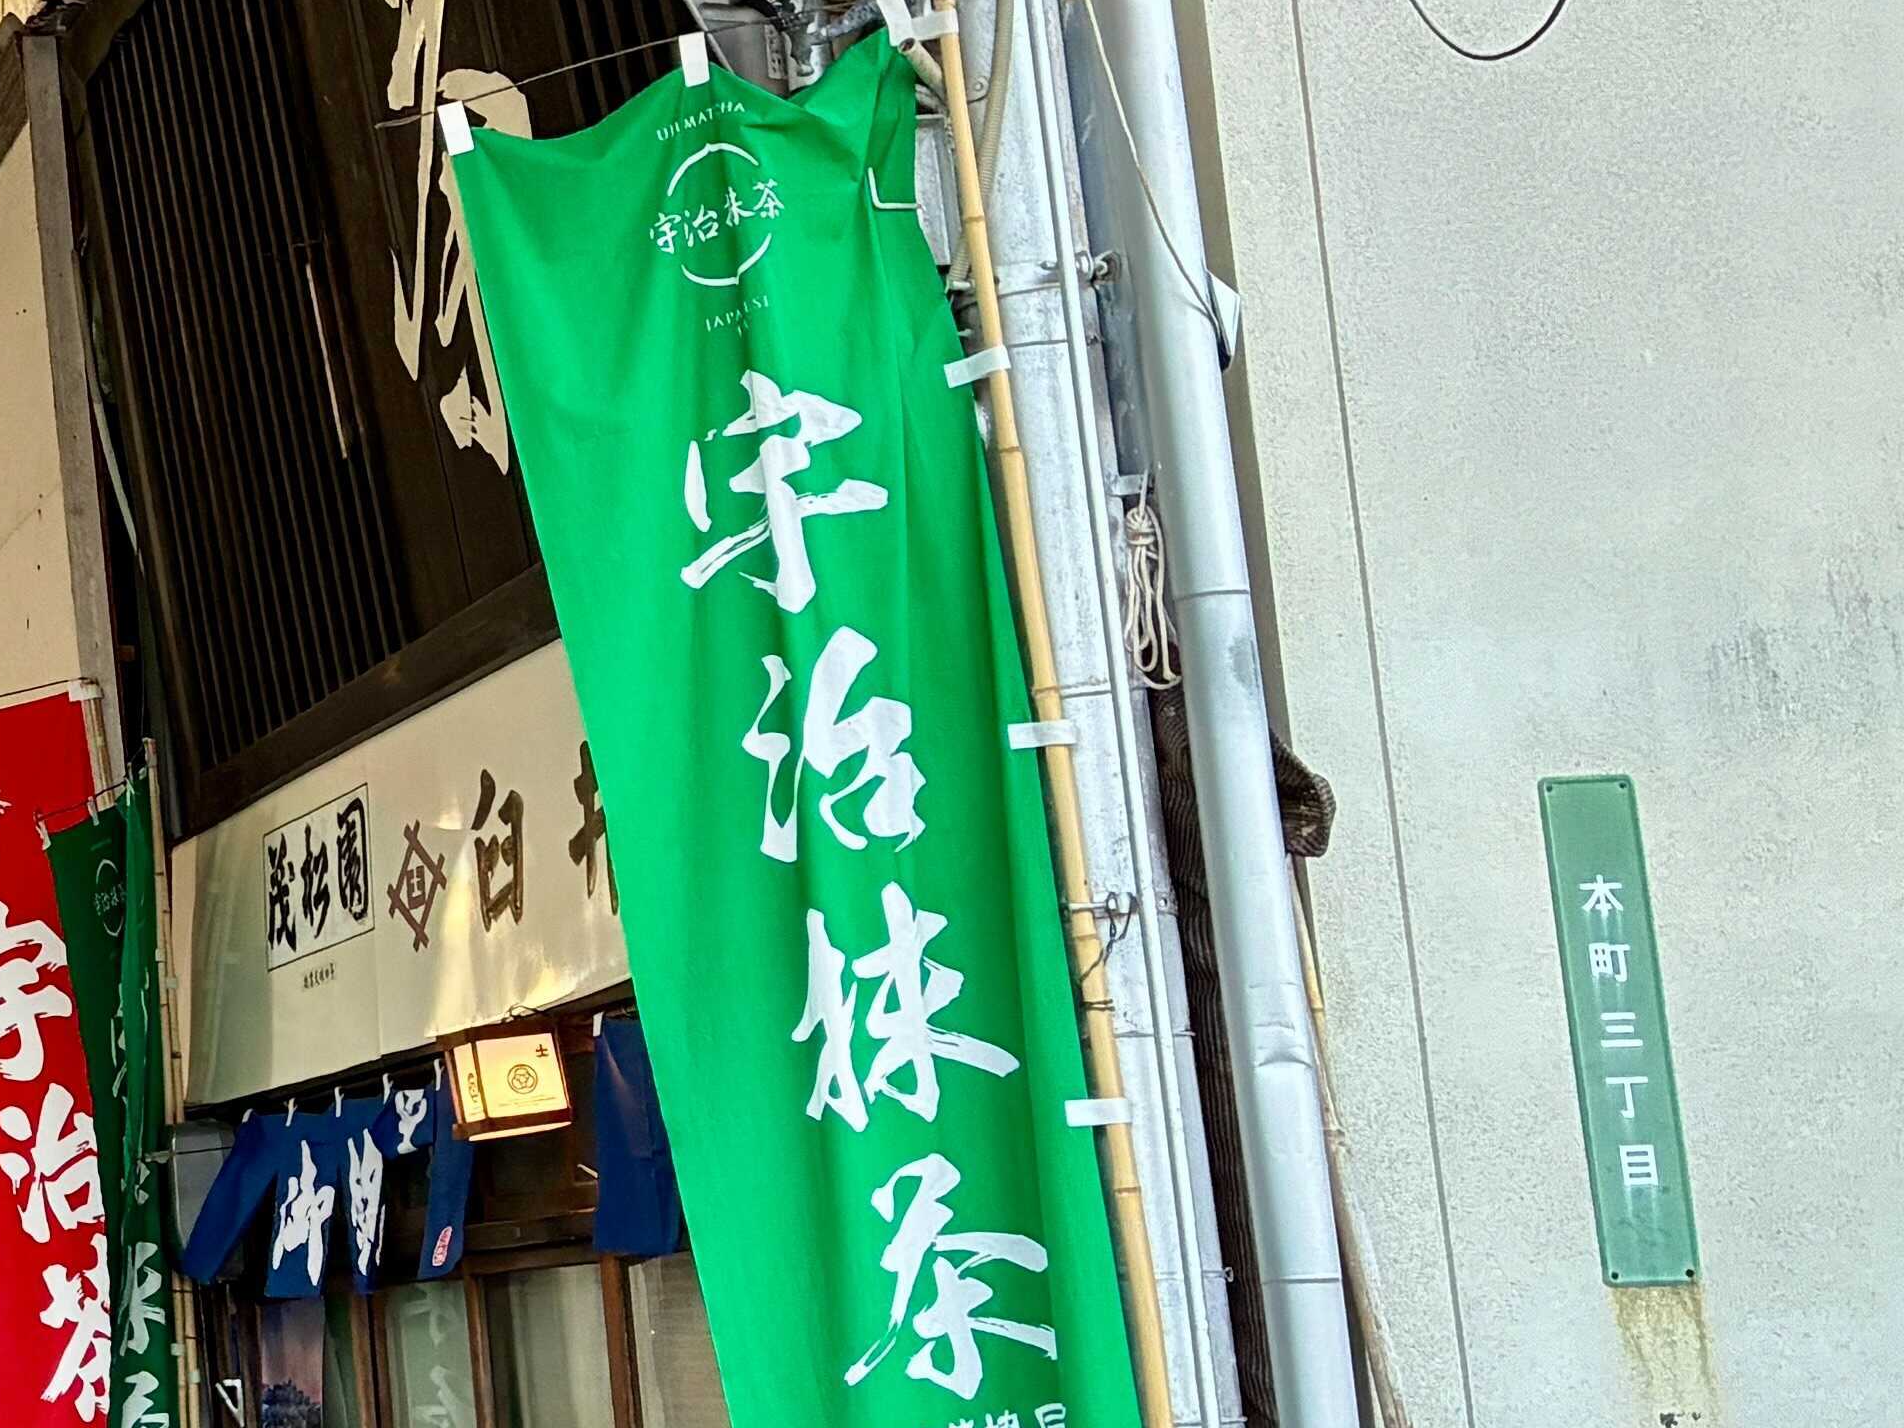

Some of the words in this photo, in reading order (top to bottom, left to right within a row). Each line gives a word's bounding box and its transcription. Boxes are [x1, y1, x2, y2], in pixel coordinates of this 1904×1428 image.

[683, 101, 745, 129] MATHA
[680, 369, 1058, 1401] 宇治抹茶
[1578, 874, 1660, 1188] 本町三丁目
